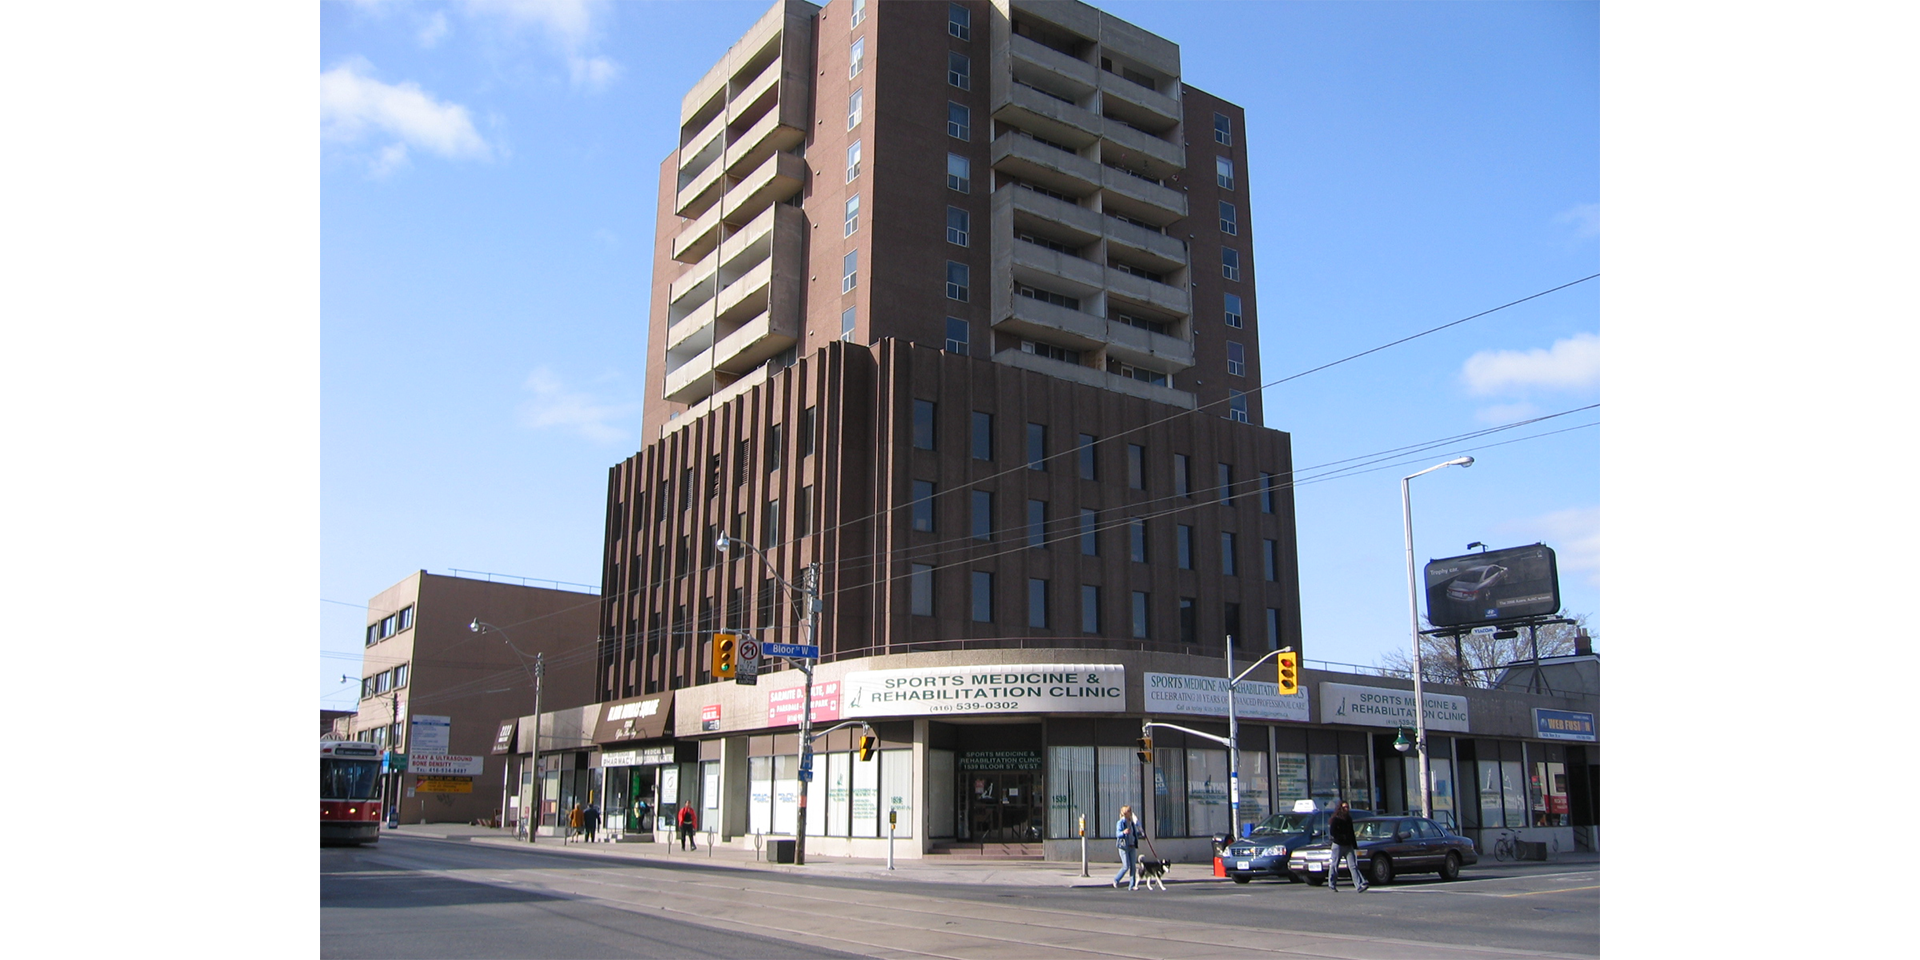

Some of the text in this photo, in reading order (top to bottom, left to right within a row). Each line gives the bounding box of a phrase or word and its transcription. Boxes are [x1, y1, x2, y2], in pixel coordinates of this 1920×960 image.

[772, 644, 794, 654] Bloor
[801, 646, 808, 655] W
[885, 673, 1100, 688] SPORTS MEDICINE &
[1151, 676, 1182, 689] SPORTS
[1184, 678, 1216, 692] MEDICINE
[770, 690, 796, 702] SARMITE
[826, 684, 837, 694] MP
[871, 686, 1120, 702] REHABILITATION CLINIC
[1151, 691, 1196, 702] CELEBRATING
[1202, 694, 1220, 704] YEARS
[1257, 698, 1291, 709] PROFESSIONAL
[1292, 701, 1306, 710] CARE
[930, 702, 1019, 713] (416) 539-0302
[1360, 693, 1458, 710] SPORTS MEICINE &
[1352, 704, 1466, 721] REHABILITATON CLINIC
[1548, 718, 1564, 730] WEB
[603, 757, 633, 765] PHARMACY
[803, 755, 811, 768] H
